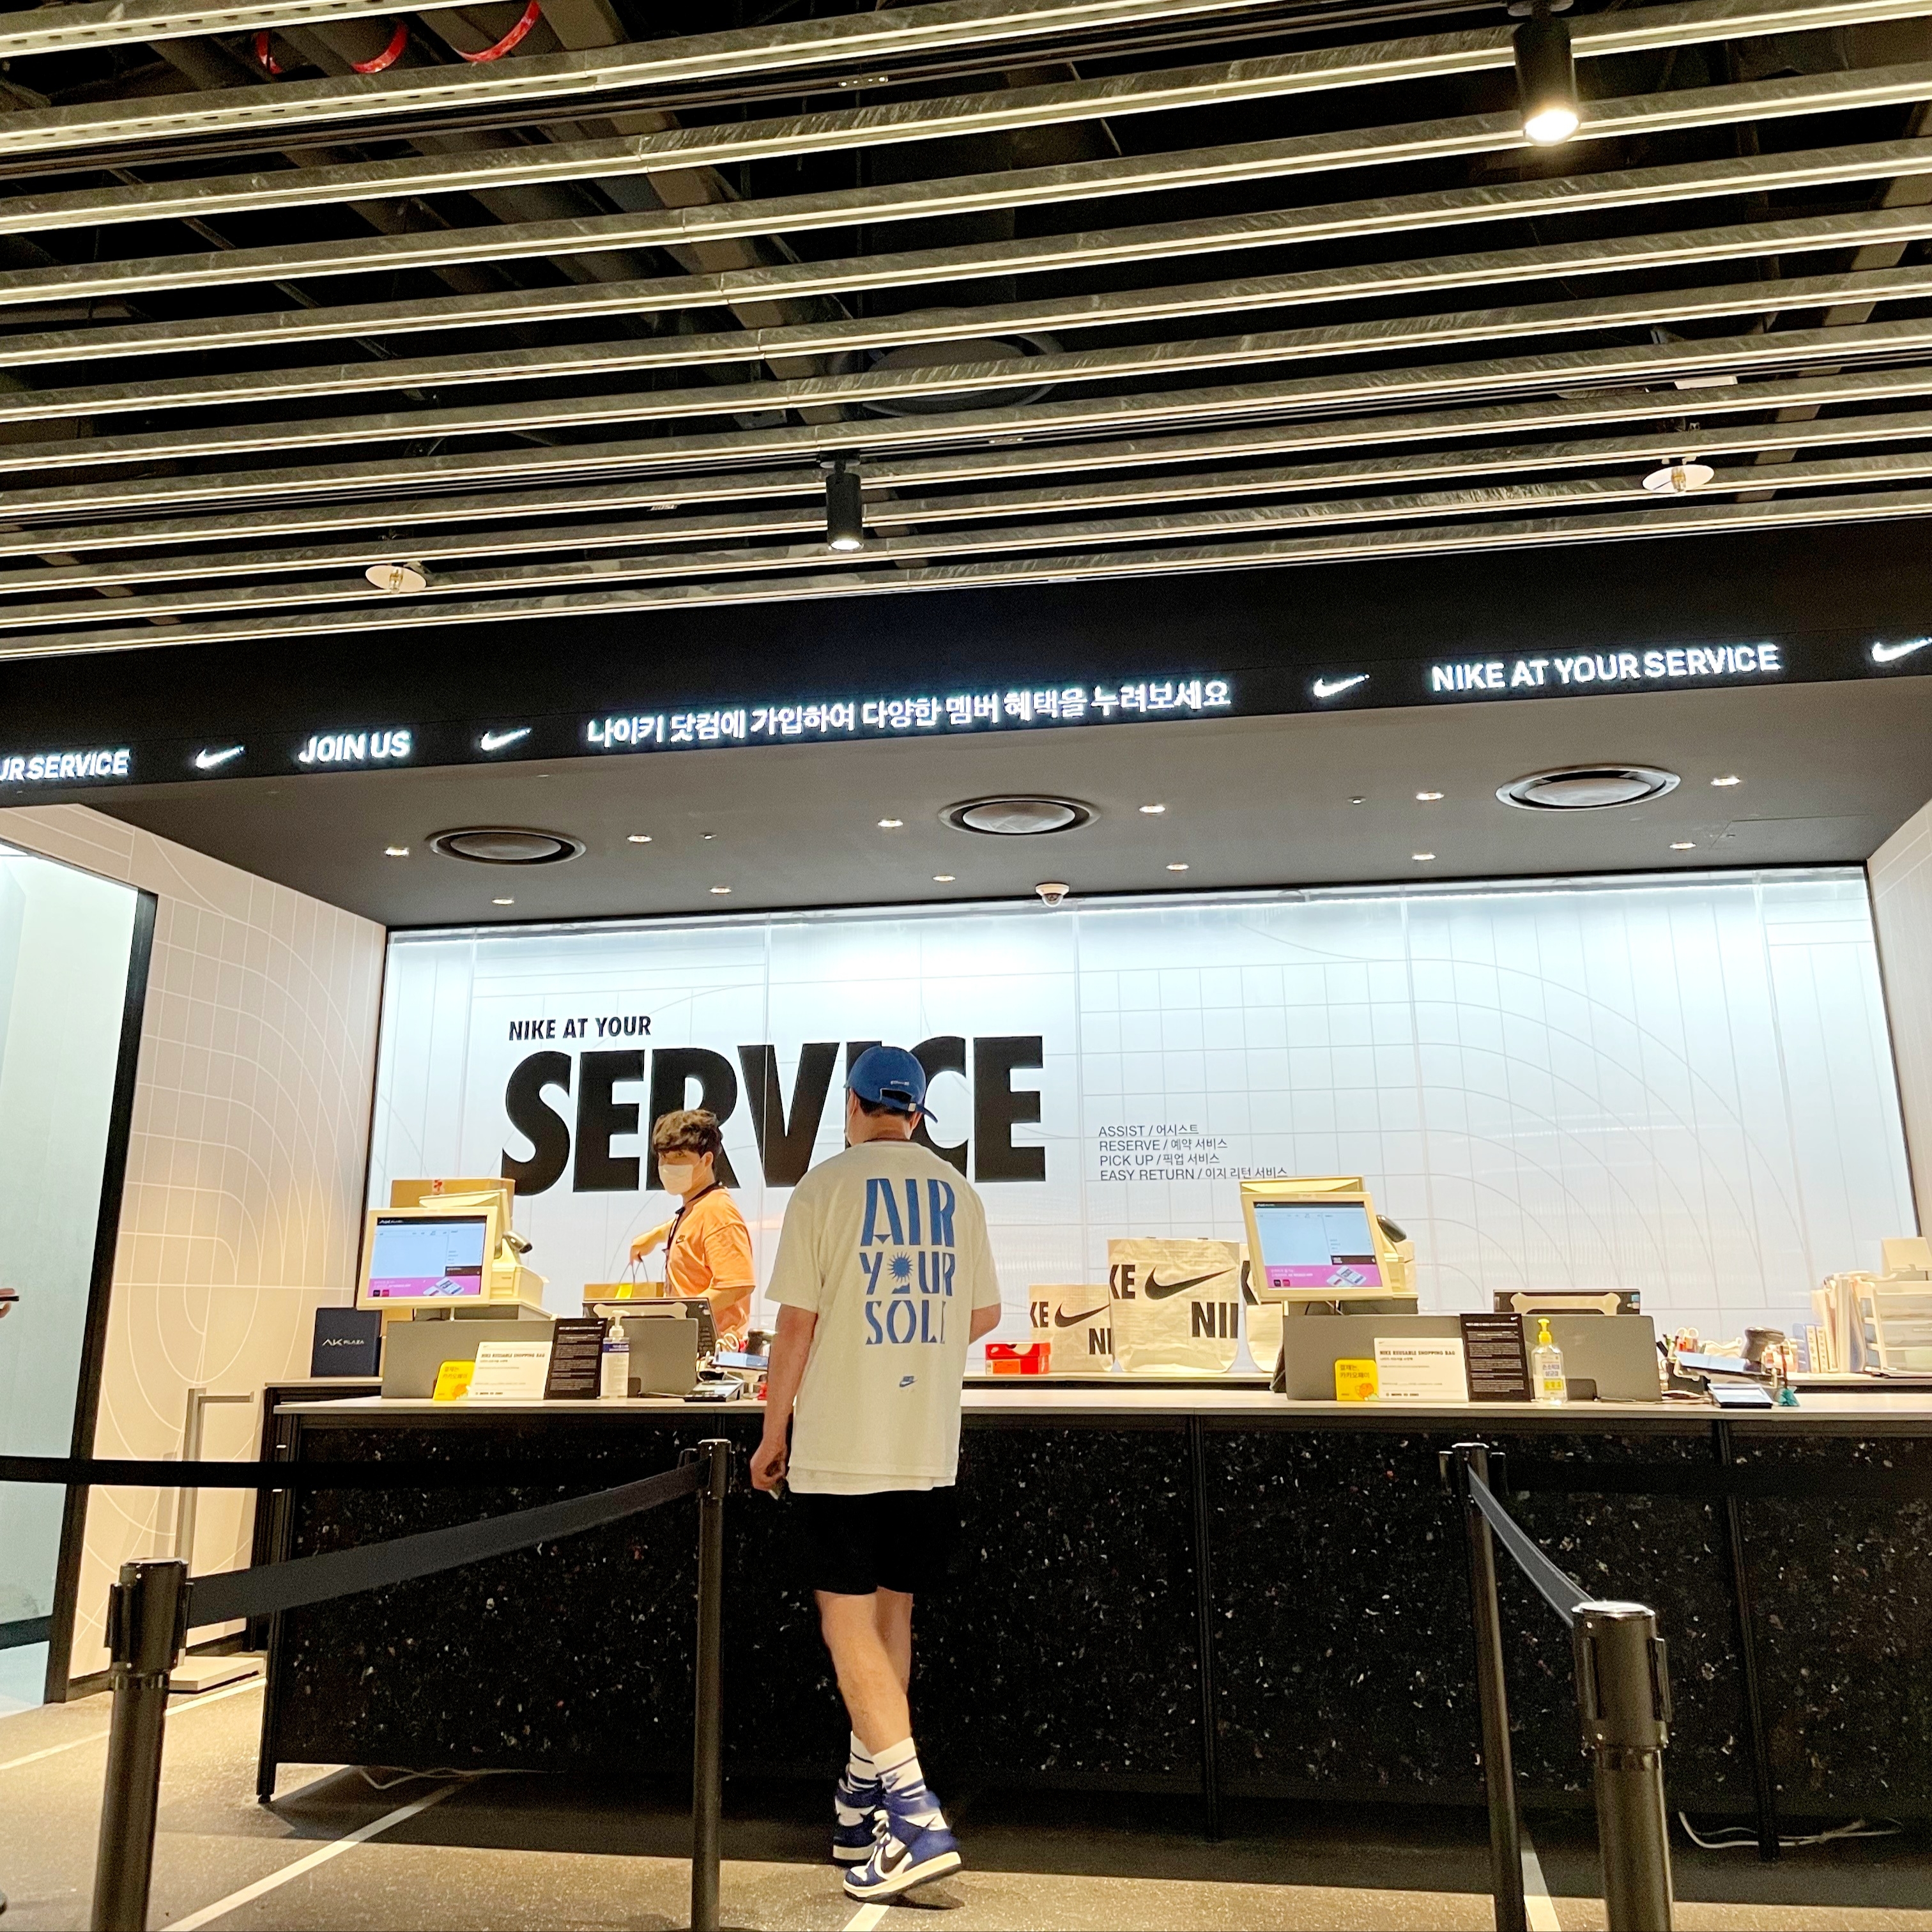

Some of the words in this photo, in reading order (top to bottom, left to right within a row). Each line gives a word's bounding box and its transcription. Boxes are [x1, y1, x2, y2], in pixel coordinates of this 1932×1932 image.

[1431, 661, 1505, 692] NIKE
[1510, 659, 1549, 687] AT
[1553, 652, 1641, 684] YOUR
[1643, 642, 1781, 678] SERVICE
[586, 713, 665, 748] 나이키
[670, 708, 746, 742] 닷컴에
[750, 702, 855, 736] 가입하여
[862, 696, 942, 729] 다양한
[946, 692, 999, 724] 멤버
[1003, 686, 1088, 721] 혜택을
[1090, 680, 1232, 716] 누려보세요
[298, 733, 366, 763] JOIN
[370, 730, 411, 758] US
[26, 749, 130, 780] SERVICE
[509, 1019, 556, 1041] NIKE
[563, 1018, 588, 1038] AT
[595, 1015, 652, 1037] YOUR
[501, 1035, 1046, 1196] SERVCE
[1098, 1125, 1145, 1137] ASSIST
[1156, 1124, 1199, 1136] 어시스트
[1099, 1140, 1161, 1151] RESERVE
[1170, 1138, 1192, 1151] 예약
[1195, 1138, 1228, 1150] 서비스
[1100, 1154, 1131, 1167] PICK
[1135, 1154, 1154, 1166] UP
[1163, 1153, 1184, 1166] 픽업
[1187, 1153, 1220, 1165] 서비스
[1100, 1169, 1136, 1181] EASY
[1139, 1169, 1195, 1181] RETURN
[1205, 1167, 1227, 1180] 이지
[1230, 1167, 1252, 1179] 리턴
[1255, 1167, 1288, 1179] 서비스
[861, 1178, 955, 1248] AIR
